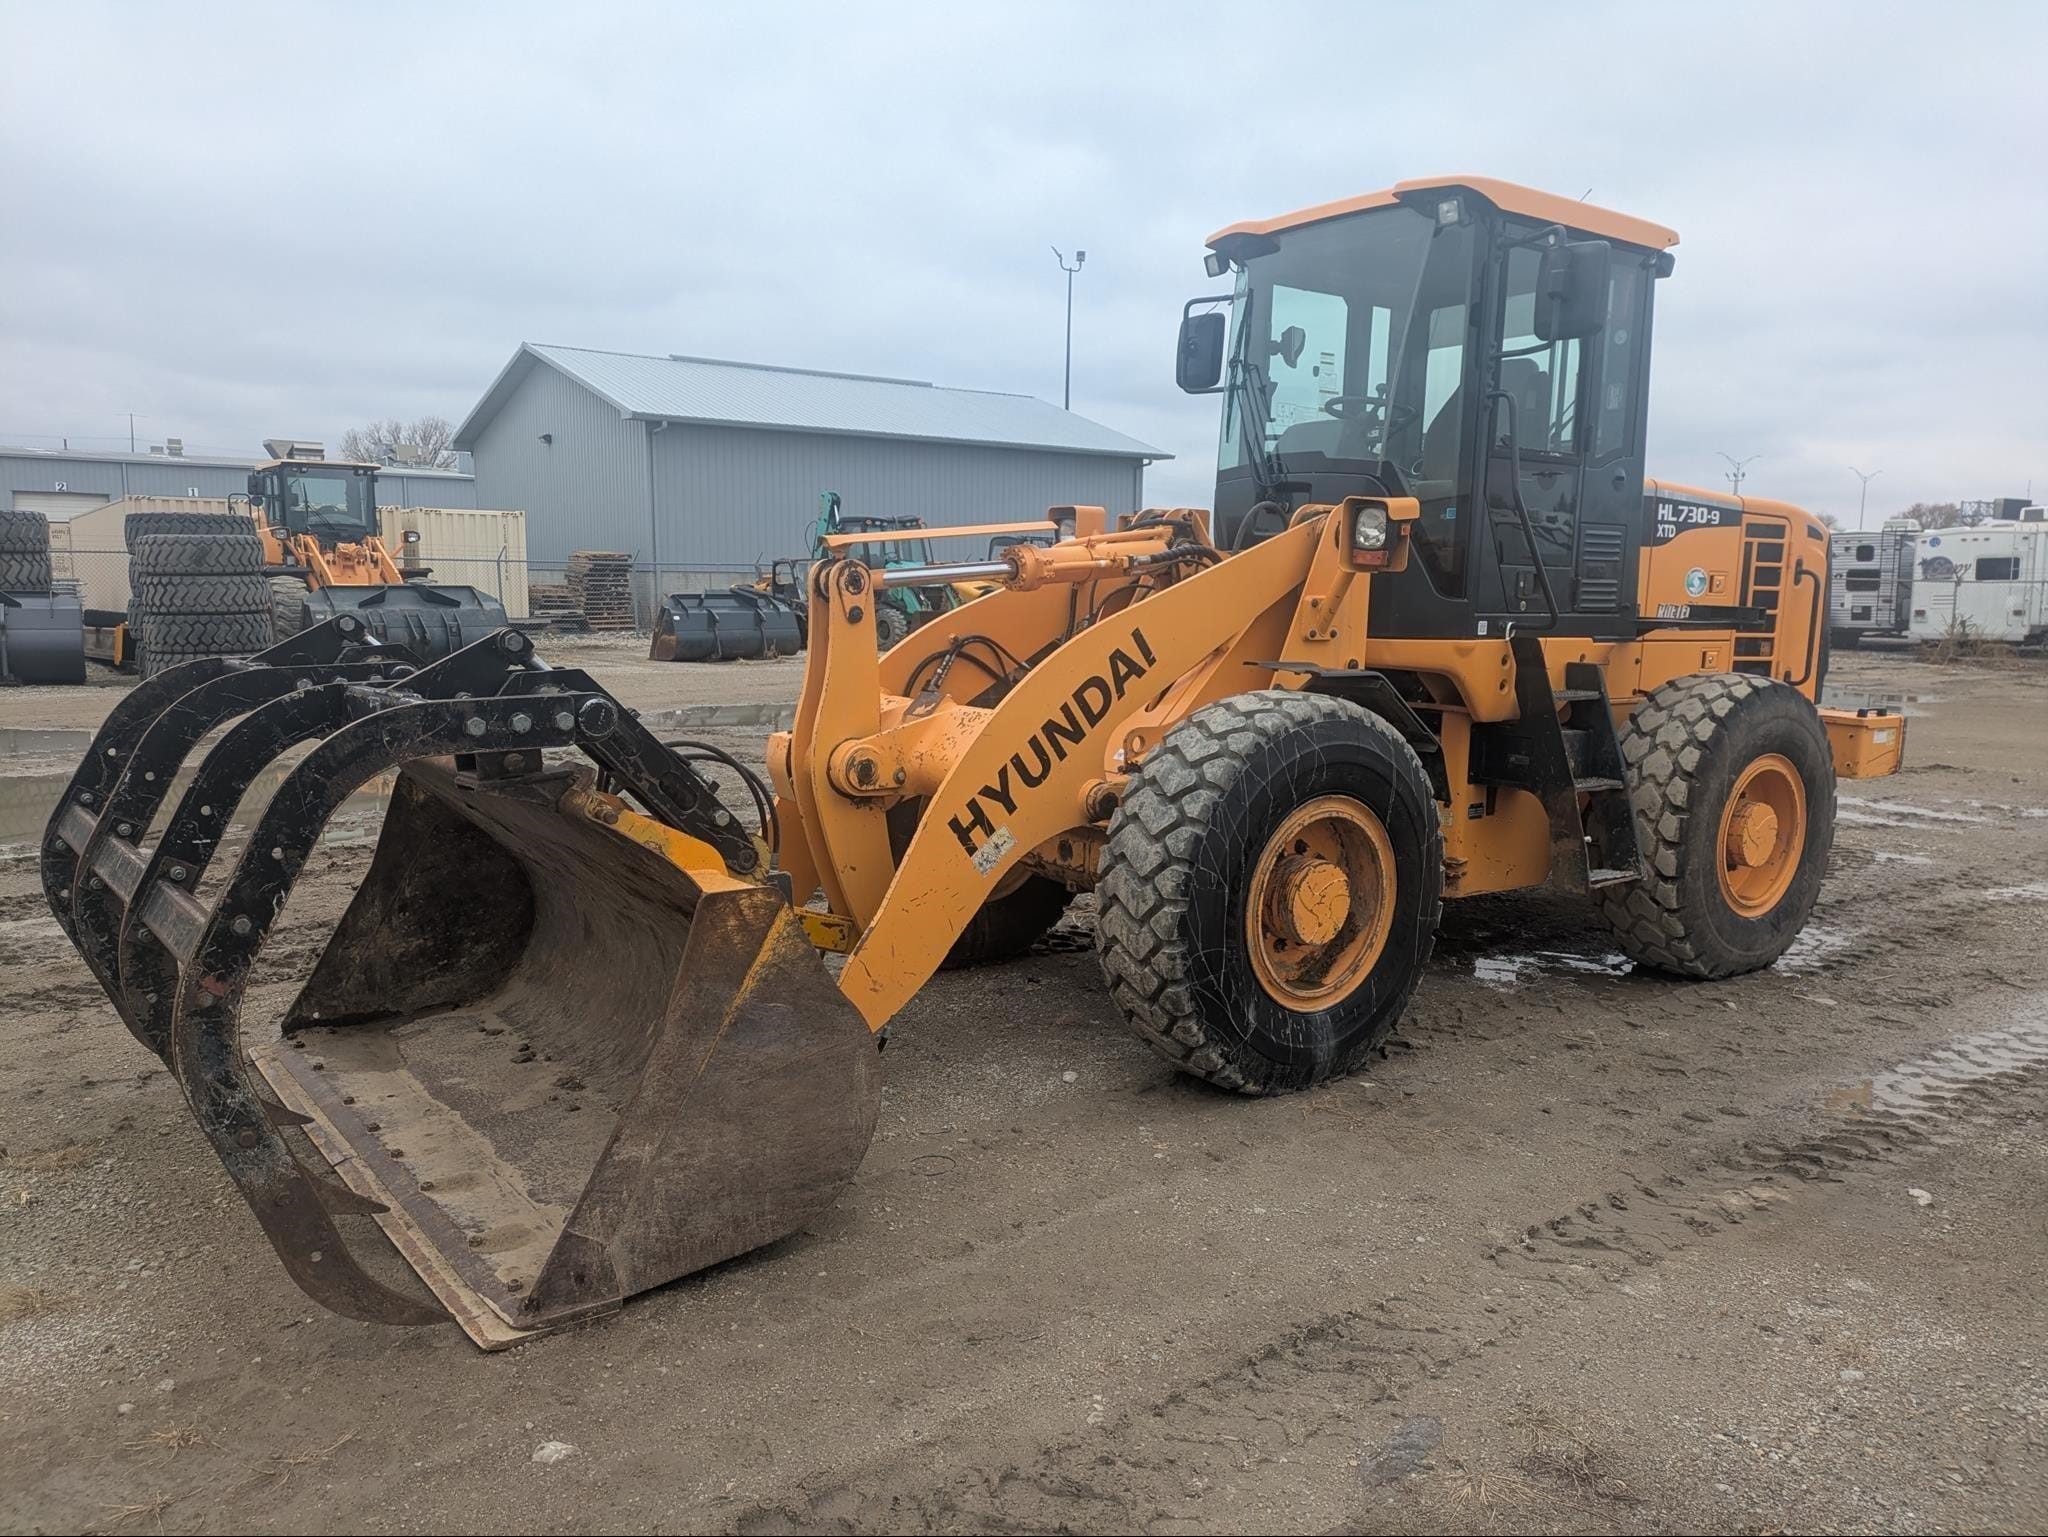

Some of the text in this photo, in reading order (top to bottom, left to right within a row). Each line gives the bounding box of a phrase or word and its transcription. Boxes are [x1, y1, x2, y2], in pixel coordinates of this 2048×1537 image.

[57, 482, 65, 492] 2
[1658, 503, 1720, 525] HL730-9
[1656, 523, 1676, 538] XTD
[948, 627, 1157, 858] HYUNDAI
